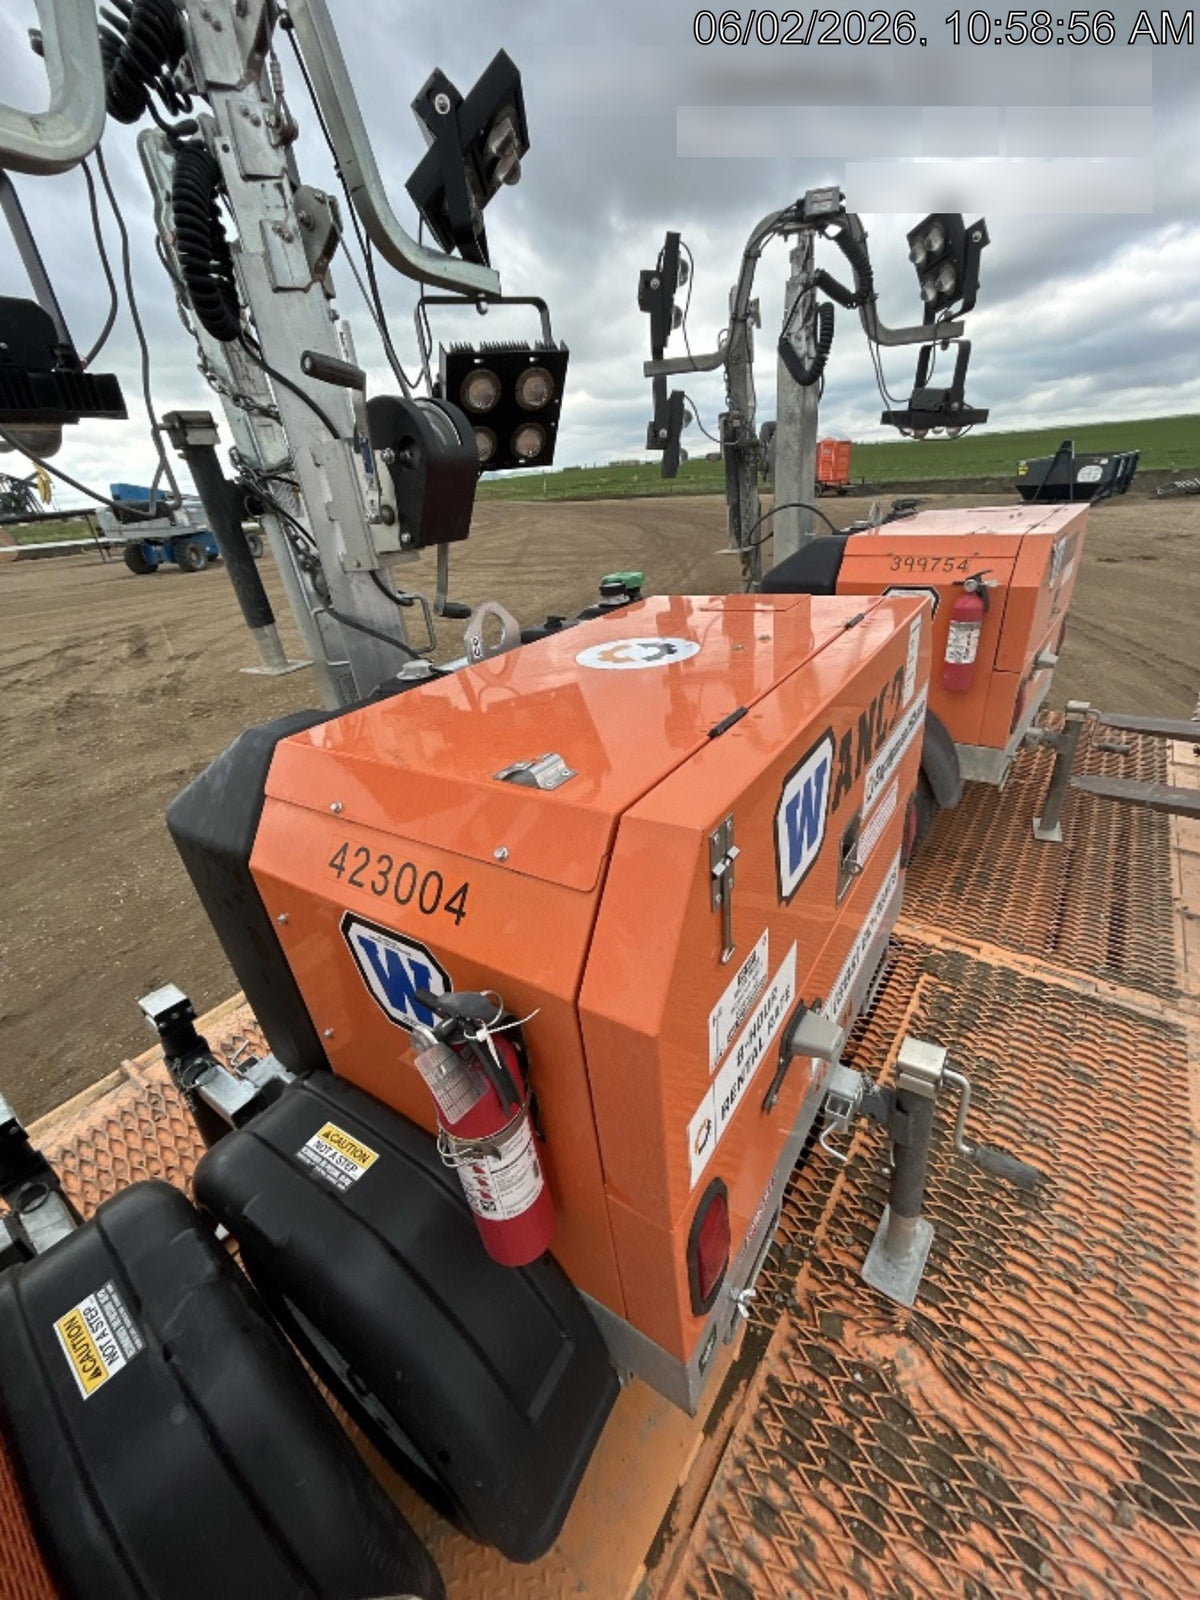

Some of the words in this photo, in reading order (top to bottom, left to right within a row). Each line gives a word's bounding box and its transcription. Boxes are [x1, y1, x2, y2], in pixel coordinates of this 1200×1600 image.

[890, 557, 970, 573] 399754
[329, 842, 469, 926] 423004
[357, 935, 435, 1027] W
[721, 1037, 765, 1121] RENTAL
[314, 1140, 333, 1154] NOT
[329, 1151, 339, 1161] A
[335, 1156, 358, 1172] STEP
[329, 1132, 371, 1164] CAUTION
[83, 1305, 105, 1334] STEP
[63, 1314, 98, 1373] CAUTION
[96, 1330, 109, 1342] A
[99, 1339, 120, 1367] NOT
